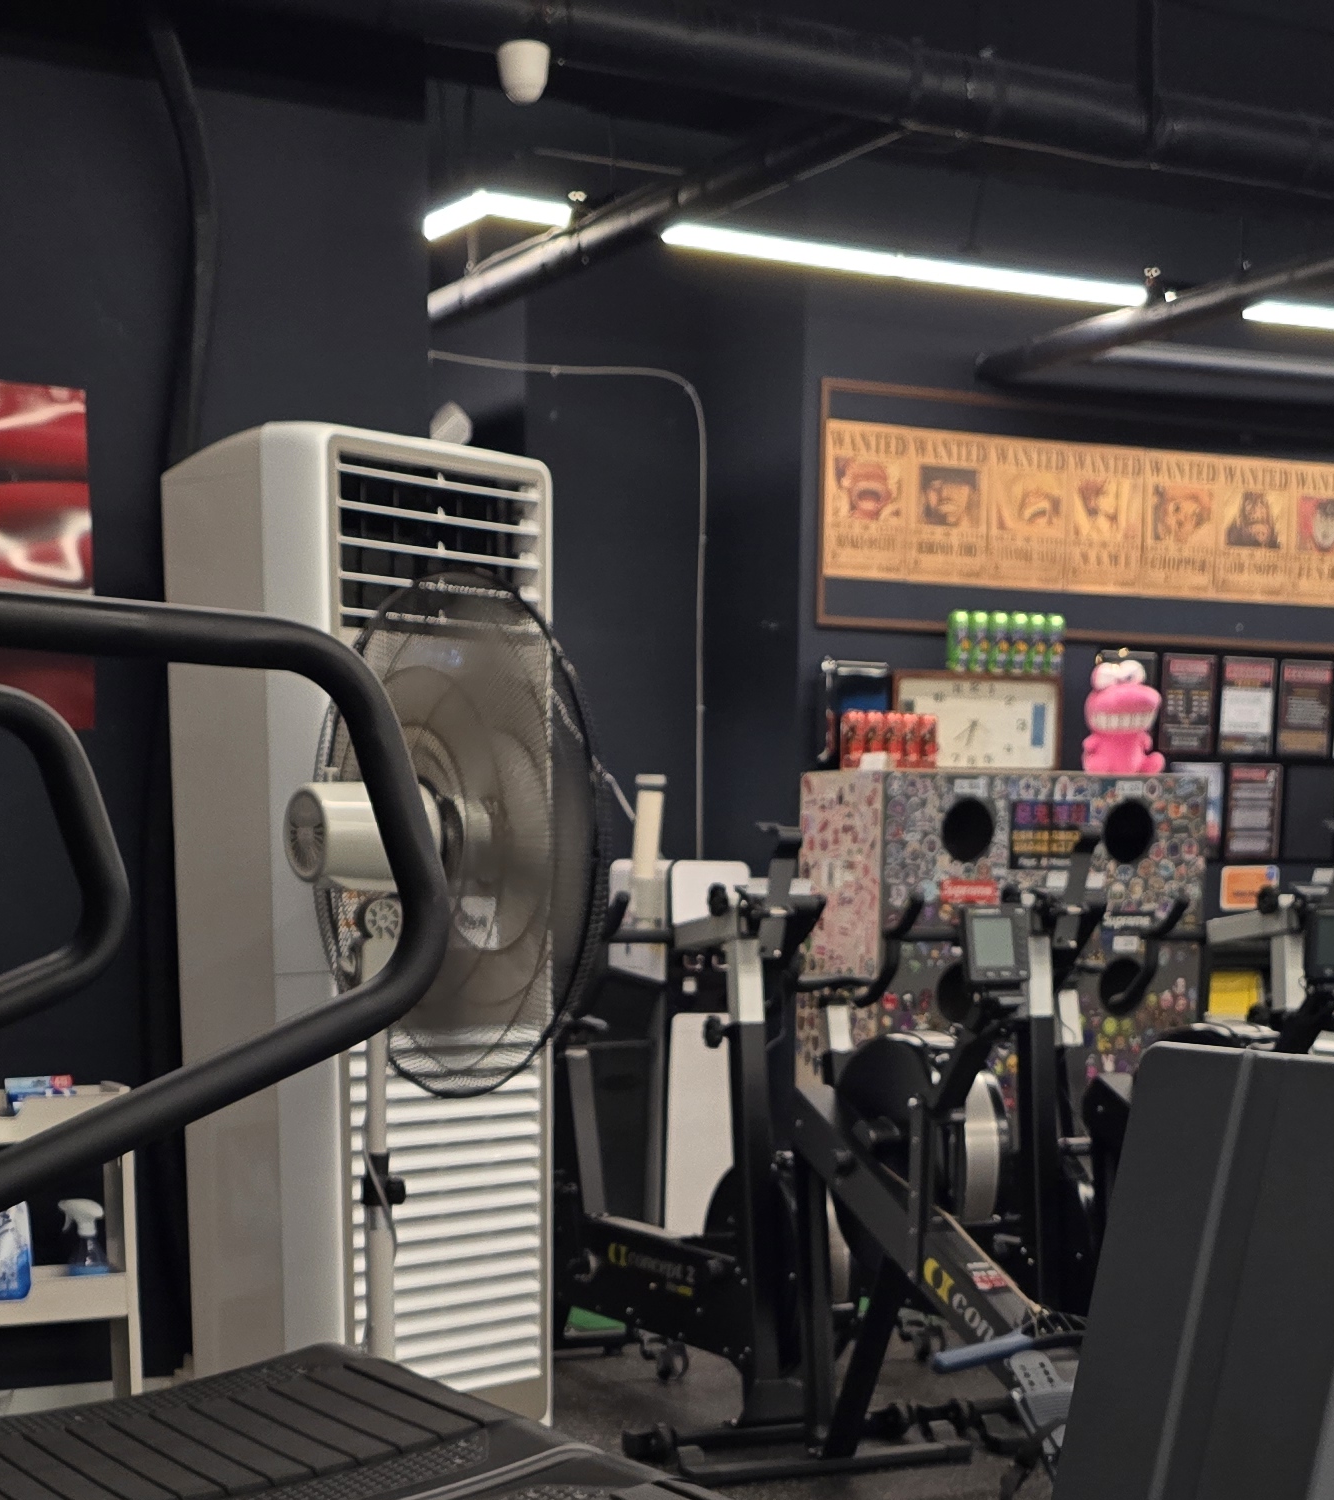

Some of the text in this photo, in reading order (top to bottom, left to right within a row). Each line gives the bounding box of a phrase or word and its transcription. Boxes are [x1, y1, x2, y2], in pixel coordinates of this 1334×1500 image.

[831, 430, 909, 455] WANTED
[913, 435, 987, 462] WANTED
[994, 445, 1066, 470] WANTED
[1074, 451, 1141, 478] WANTED
[1149, 458, 1216, 482] WANTED
[1223, 464, 1289, 489] WANTED
